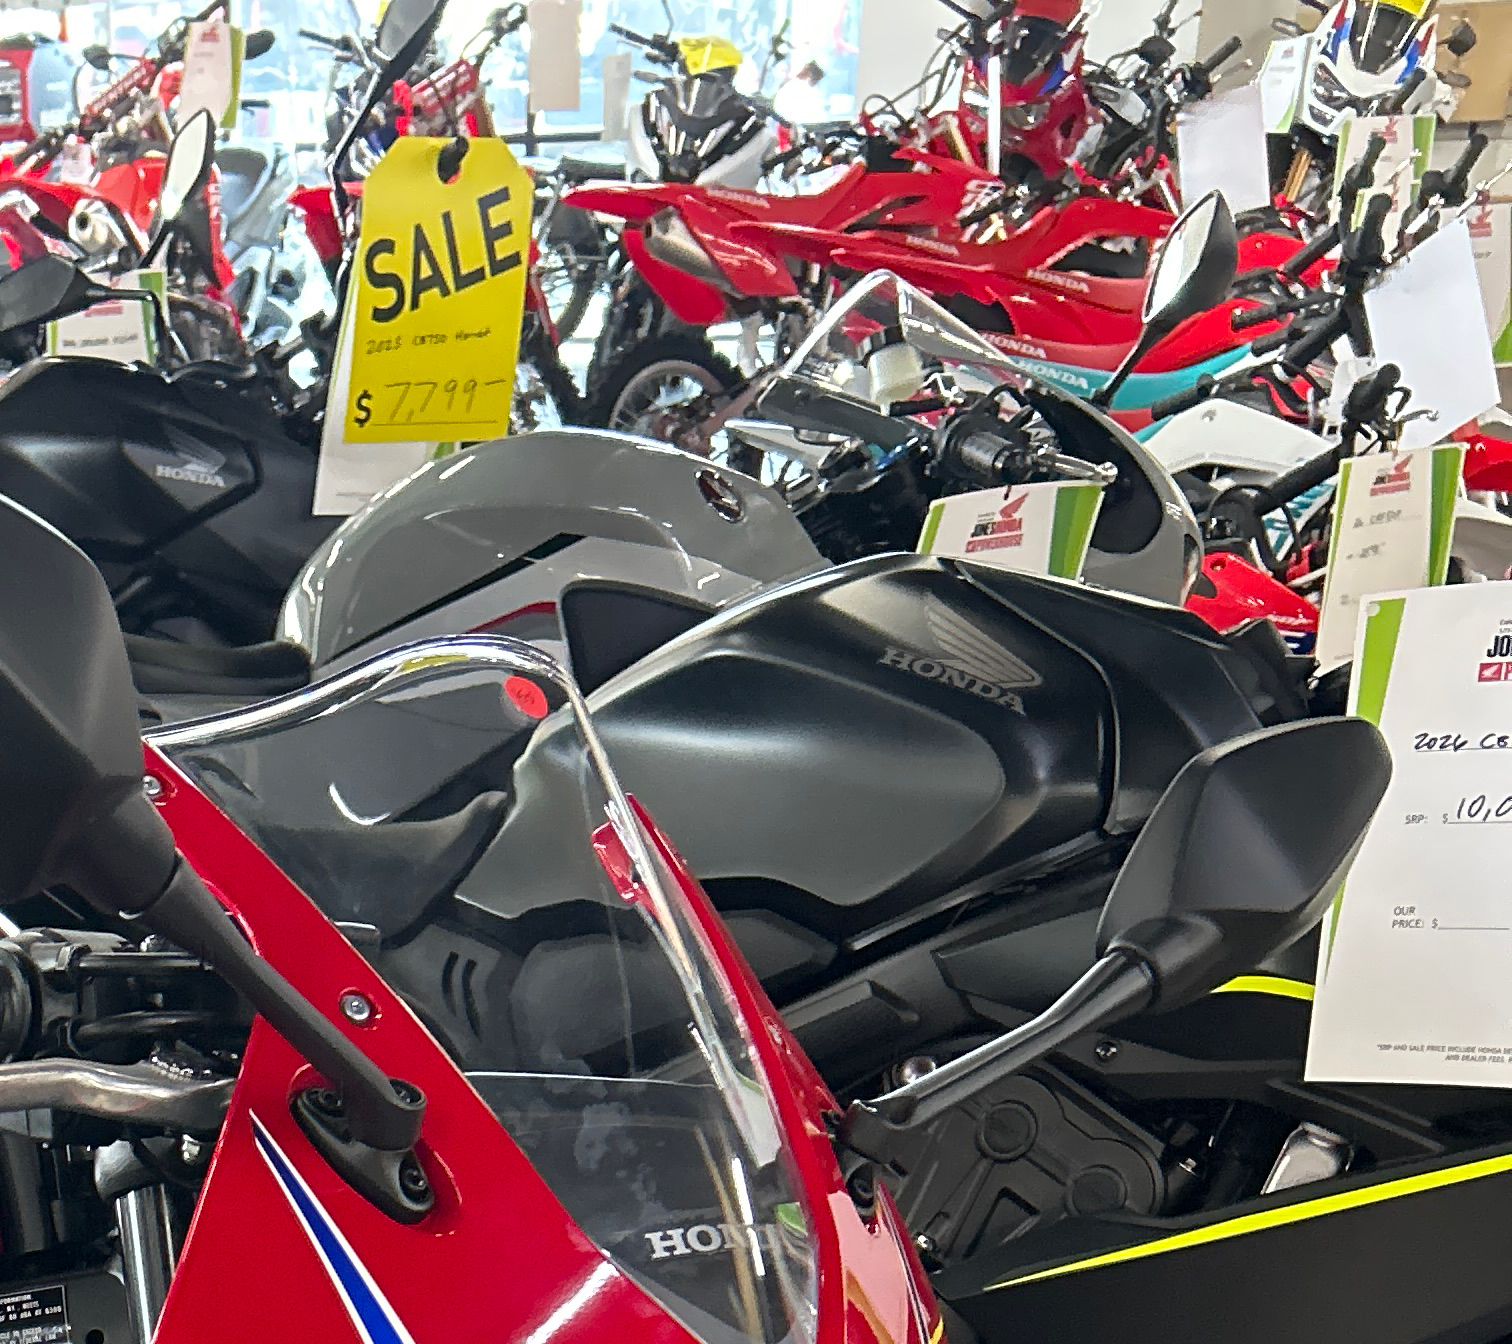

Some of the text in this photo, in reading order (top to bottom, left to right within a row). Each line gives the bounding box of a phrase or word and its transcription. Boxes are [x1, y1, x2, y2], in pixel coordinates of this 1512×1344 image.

[364, 186, 523, 324] SALE
[1026, 268, 1090, 293] HONDA
[1018, 359, 1089, 389] HONDA
[352, 389, 372, 428] $
[155, 464, 227, 488] HONDA
[1486, 634, 1512, 657] JO
[877, 648, 1026, 716] HONDA
[1414, 732, 1469, 753] 2026
[1393, 906, 1416, 916] OUR
